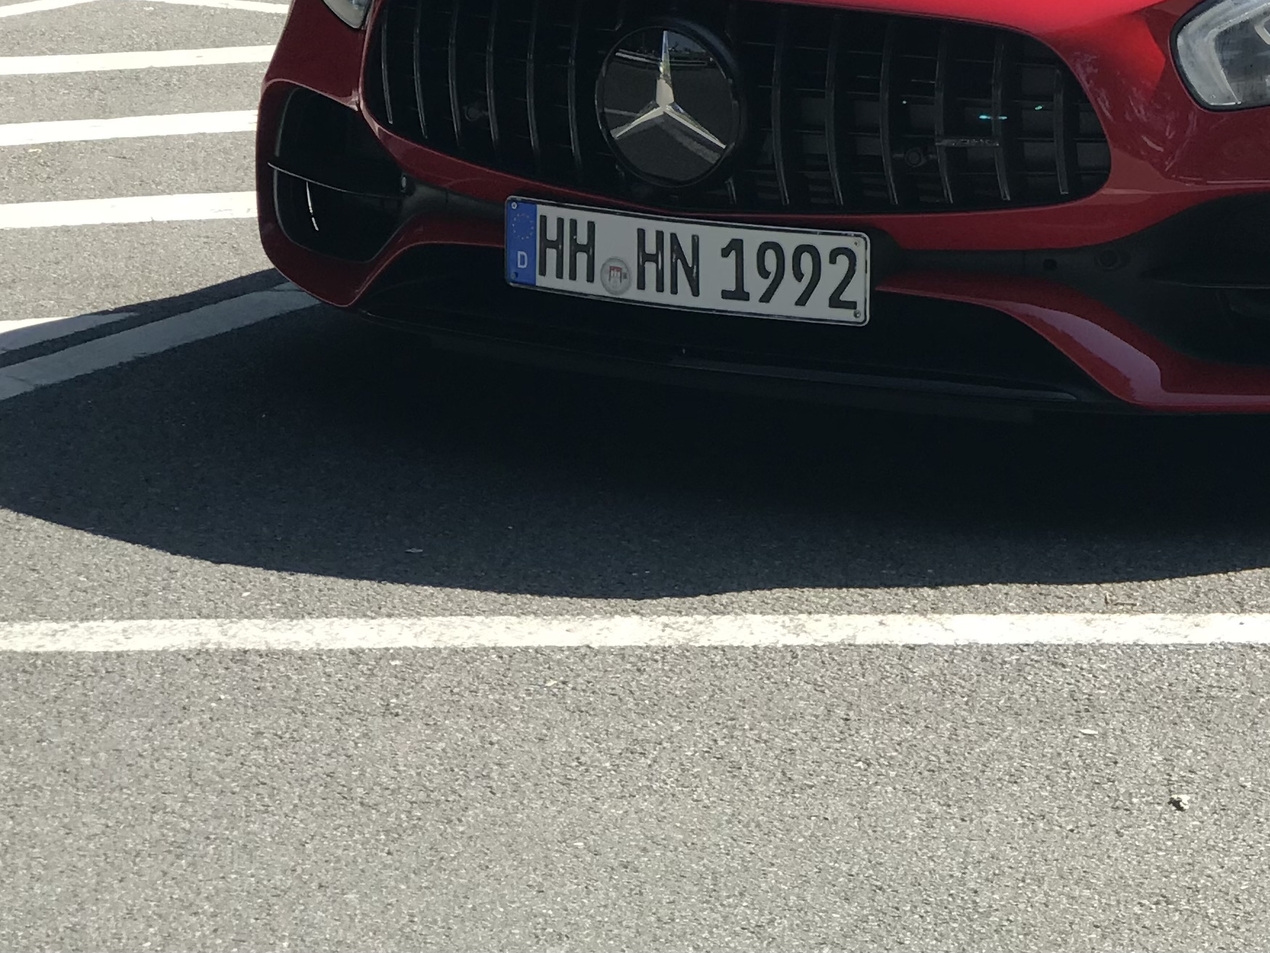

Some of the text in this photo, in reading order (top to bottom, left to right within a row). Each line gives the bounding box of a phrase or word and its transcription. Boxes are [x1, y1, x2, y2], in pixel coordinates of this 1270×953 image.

[516, 250, 528, 269] D
[539, 214, 858, 310] HH HN 1992
